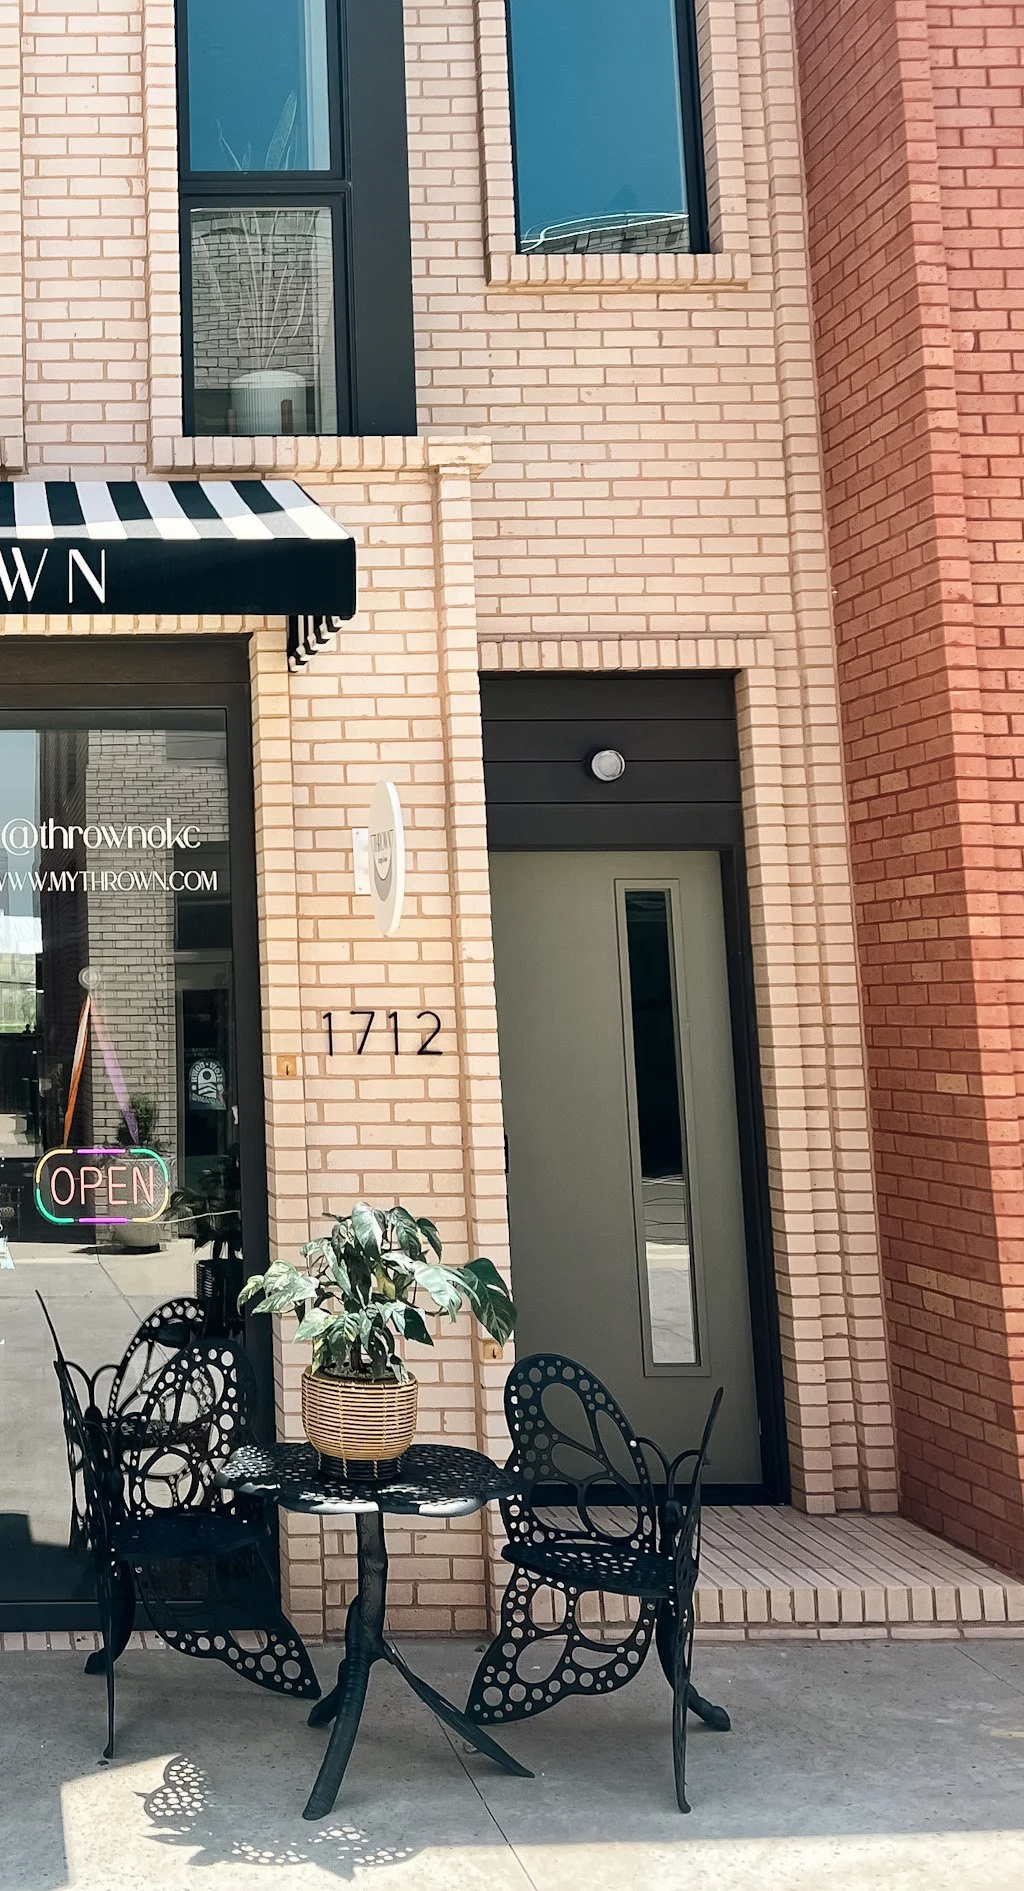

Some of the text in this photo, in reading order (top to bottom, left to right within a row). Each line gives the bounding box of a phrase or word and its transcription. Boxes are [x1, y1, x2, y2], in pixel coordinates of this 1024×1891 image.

[0, 817, 201, 856] @thrownokc
[321, 1010, 444, 1057] 1712
[50, 1166, 156, 1206] OPEN
